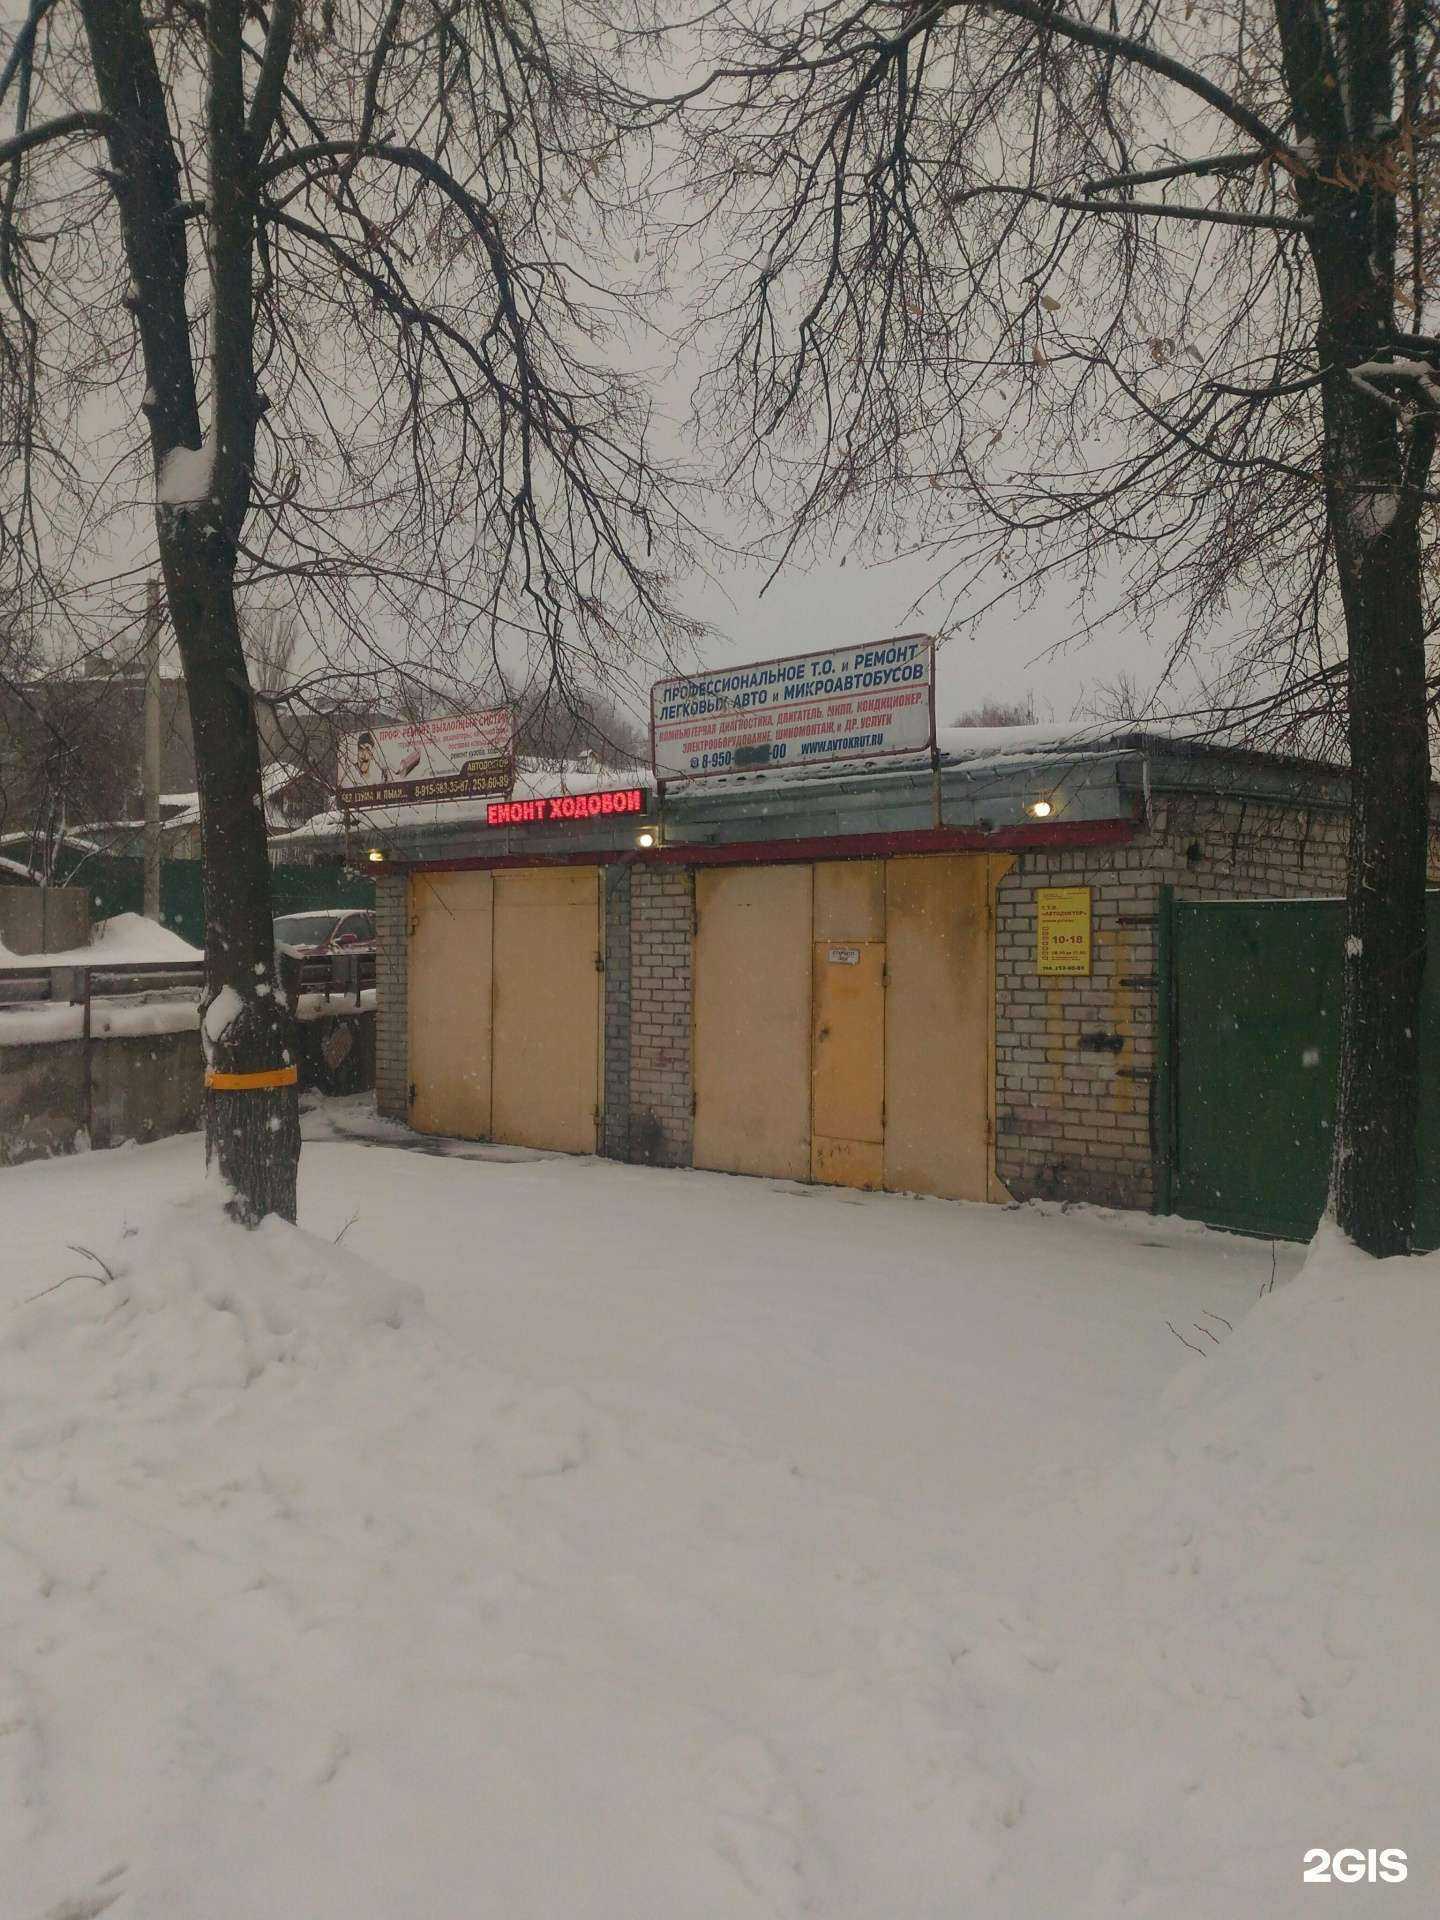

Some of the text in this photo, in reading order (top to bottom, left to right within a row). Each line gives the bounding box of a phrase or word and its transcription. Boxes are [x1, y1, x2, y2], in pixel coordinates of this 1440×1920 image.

[664, 664, 805, 702] ПРОФЕССИОНАЛЬНОЕ
[854, 645, 918, 669] РЕМОНТ
[733, 690, 767, 708] АВТО
[772, 692, 779, 702] и
[784, 664, 924, 700] МИКРОАВТОБУСОВ
[801, 733, 884, 754] WWW.AVTOKRUT.RU
[488, 800, 546, 824] ЕМОНТ
